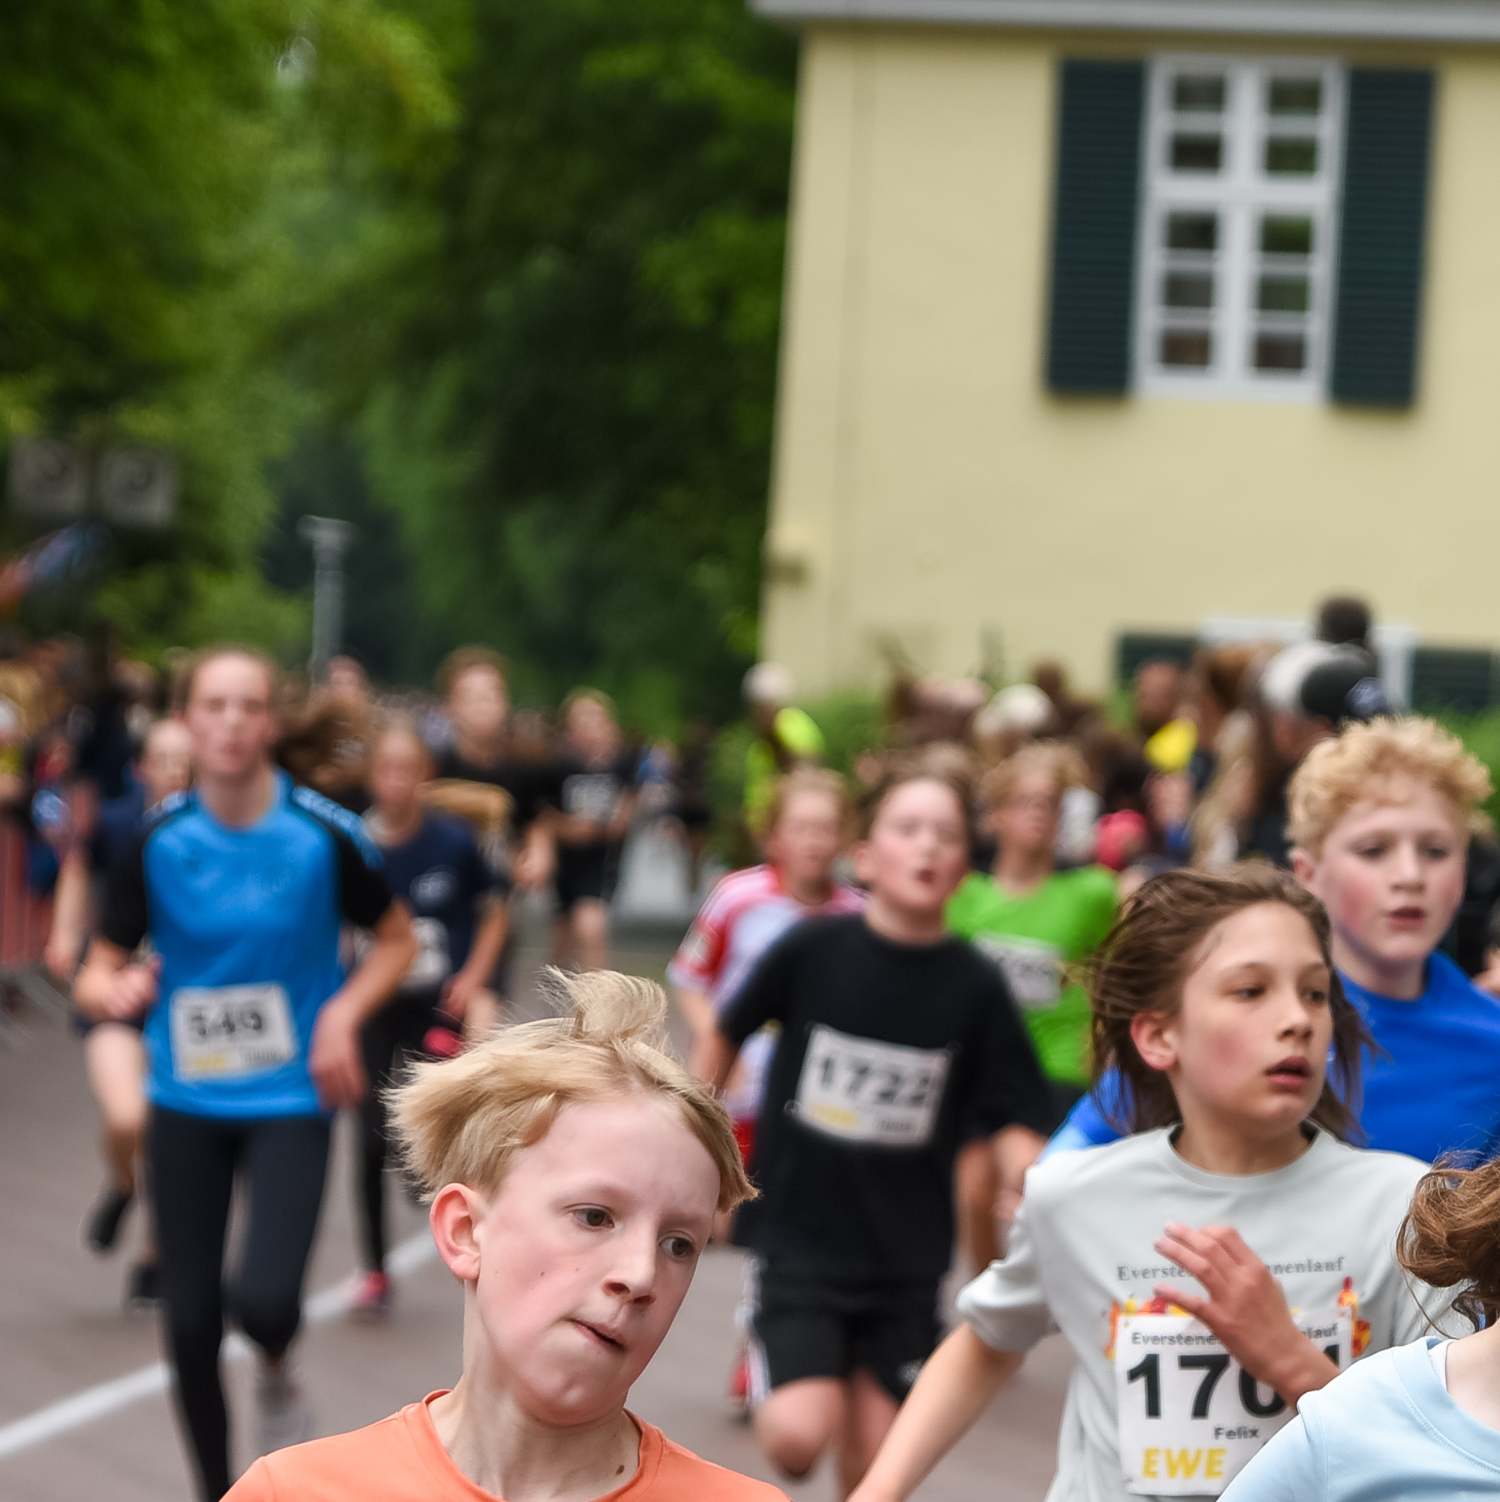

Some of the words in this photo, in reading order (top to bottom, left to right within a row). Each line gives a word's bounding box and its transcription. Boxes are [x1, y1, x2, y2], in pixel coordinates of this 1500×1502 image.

[1116, 1264, 1194, 1281] Everste
[1126, 1343, 1340, 1420] 170
[1213, 1426, 1260, 1441] Felix
[1142, 1447, 1227, 1480] EWE
